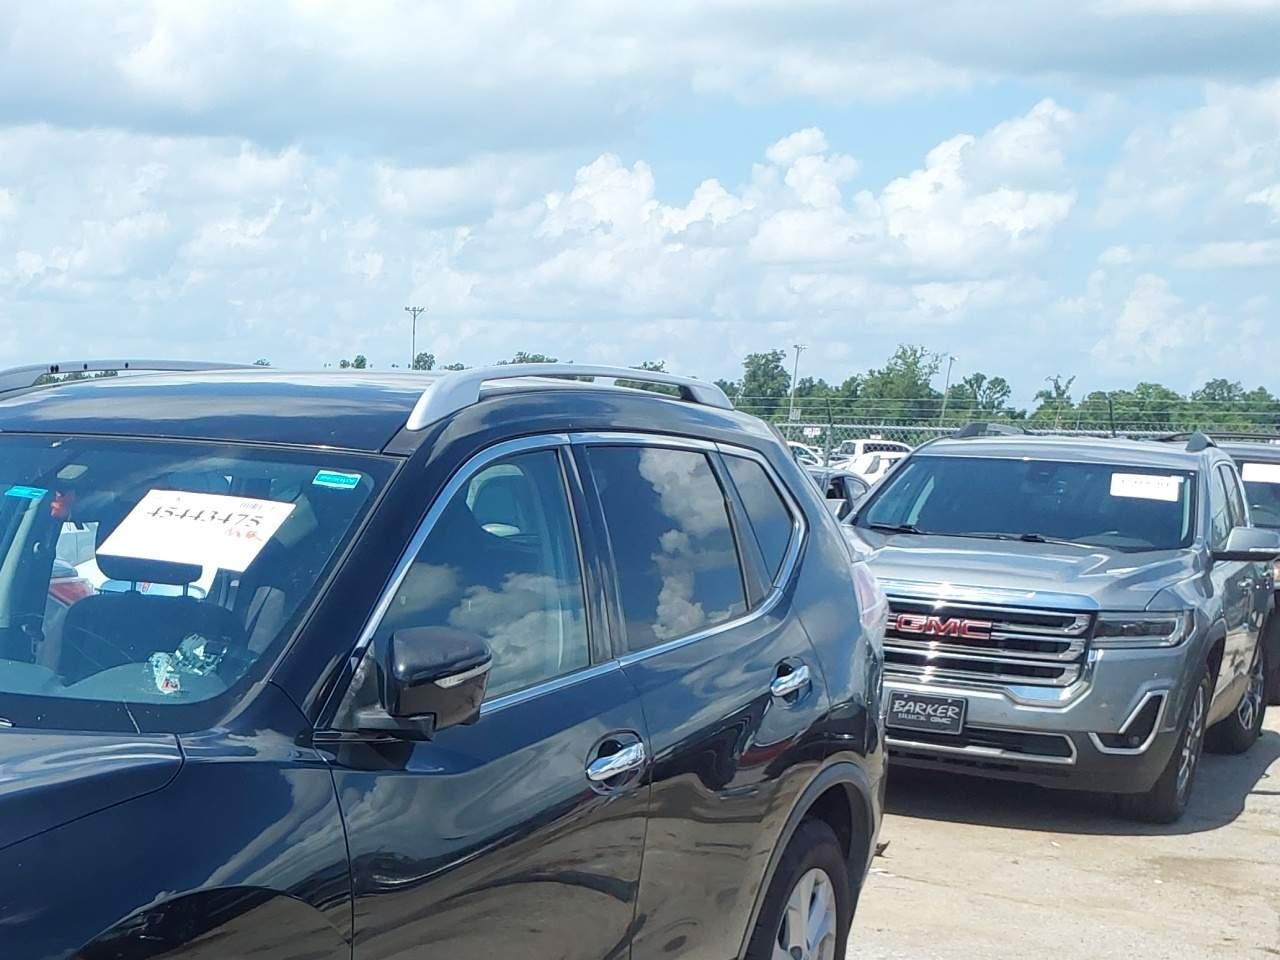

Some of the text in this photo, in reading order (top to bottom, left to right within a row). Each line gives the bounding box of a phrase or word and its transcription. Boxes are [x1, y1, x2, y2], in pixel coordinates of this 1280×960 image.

[146, 505, 264, 528] 45443475
[896, 613, 992, 640] GMC
[892, 699, 960, 720] BARKER
